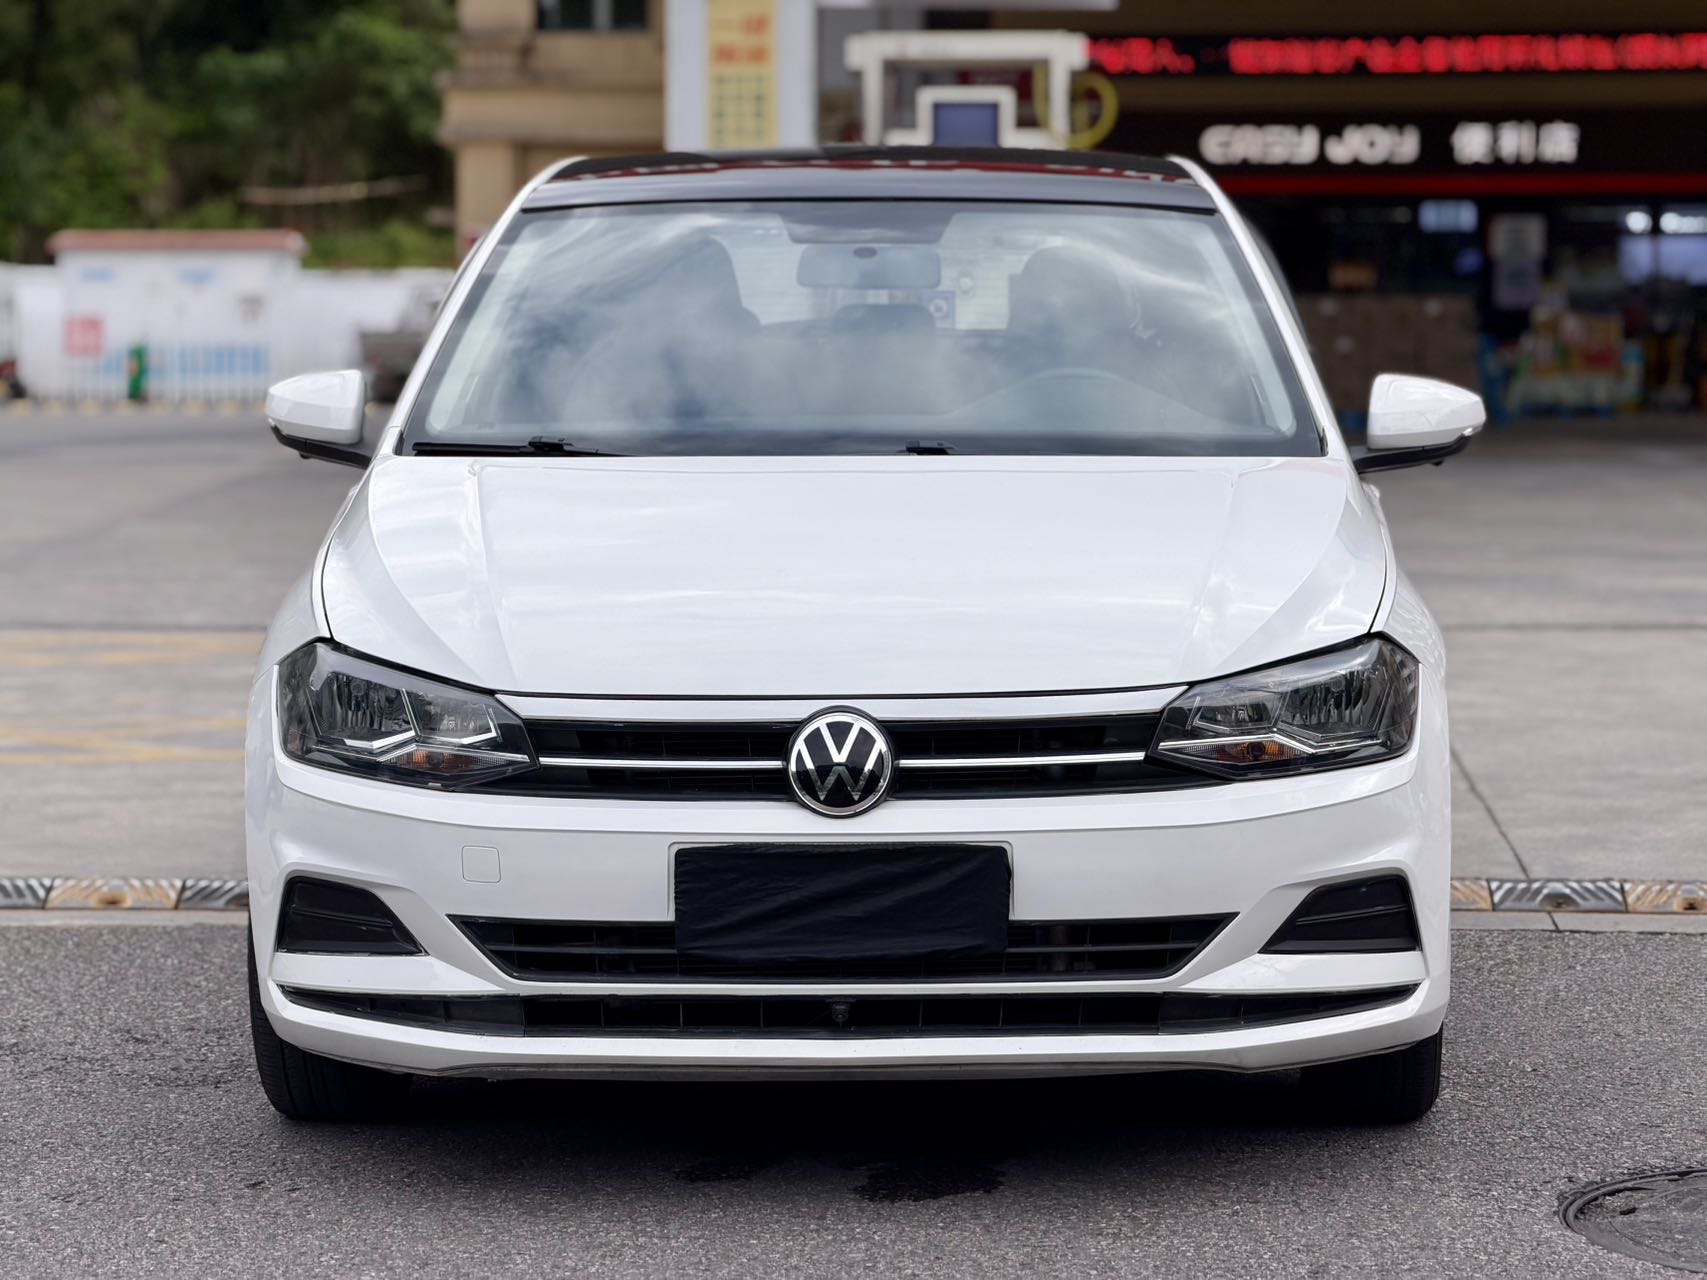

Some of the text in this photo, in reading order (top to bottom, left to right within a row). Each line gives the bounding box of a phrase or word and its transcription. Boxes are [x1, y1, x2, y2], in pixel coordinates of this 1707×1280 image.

[1324, 124, 1421, 165] JOY
[1451, 121, 1581, 164] 便利店
[791, 715, 890, 809] VW
